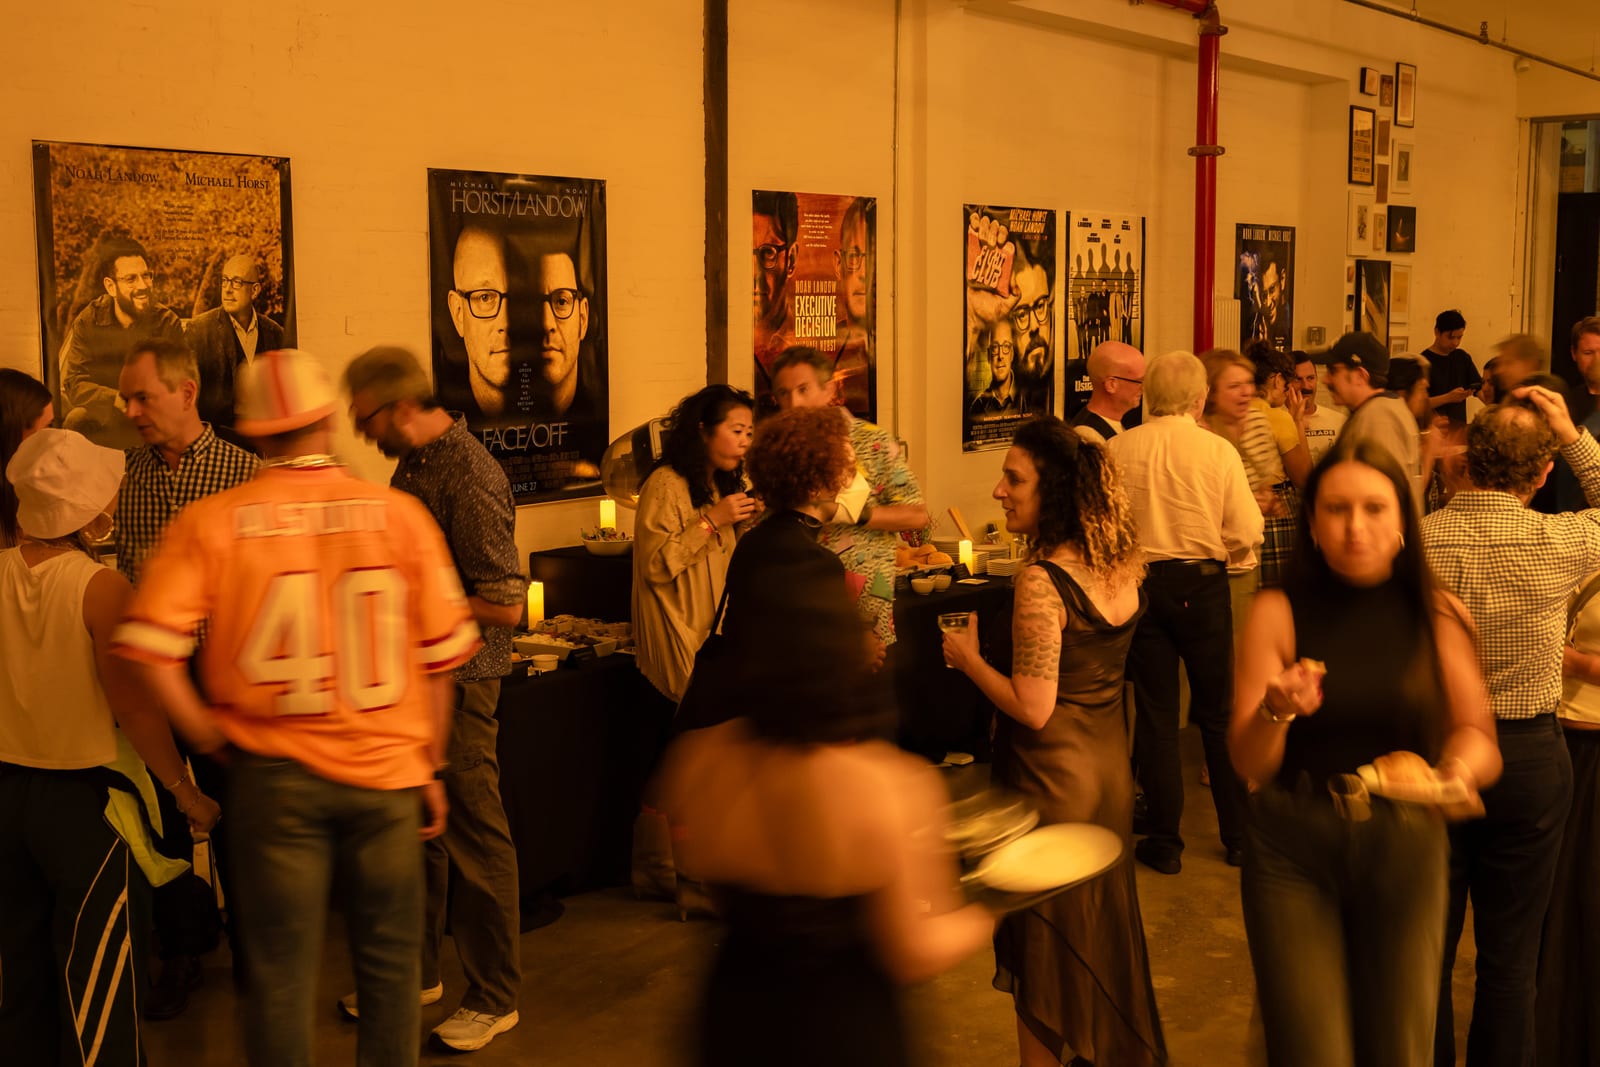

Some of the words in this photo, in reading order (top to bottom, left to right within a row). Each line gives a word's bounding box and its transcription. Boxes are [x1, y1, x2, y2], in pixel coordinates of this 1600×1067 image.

[185, 172, 235, 188] MICHAEL
[237, 175, 271, 191] HORST
[450, 182, 494, 190] MICHAEL
[451, 189, 588, 218] HORST/LANDOW
[981, 245, 1007, 267] FIGHT
[972, 255, 1003, 288] CLUB
[795, 280, 812, 294] NOAH
[813, 280, 837, 294] LANDOW
[795, 295, 837, 317] EXECUTIVE
[795, 316, 837, 338] DECISION
[1075, 380, 1094, 392] Usua
[482, 422, 569, 452] FACE/OFF
[512, 483, 529, 493] JUNE
[529, 481, 537, 491] 27
[234, 565, 410, 719] 40
